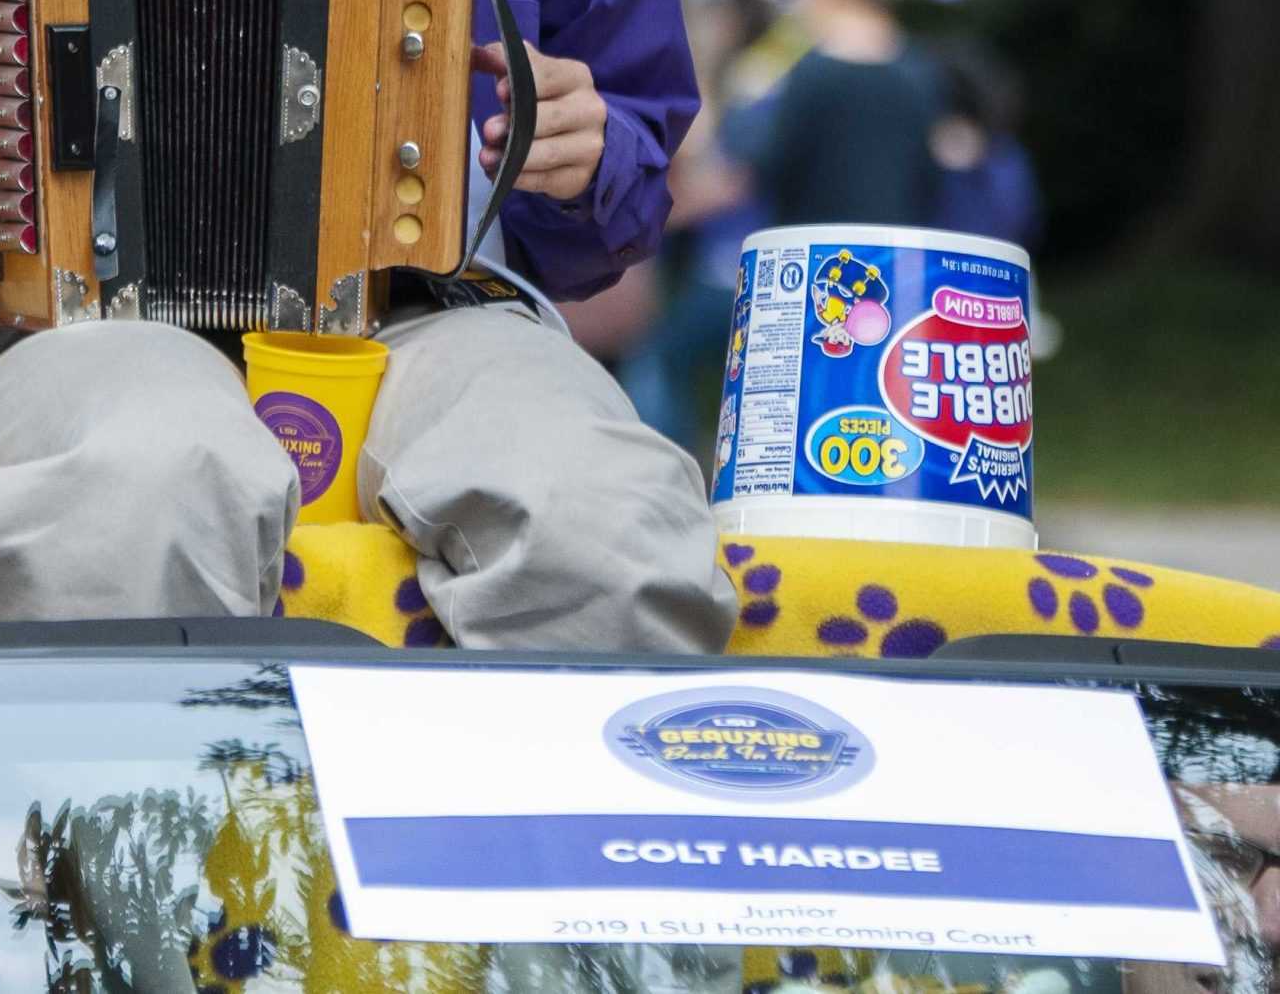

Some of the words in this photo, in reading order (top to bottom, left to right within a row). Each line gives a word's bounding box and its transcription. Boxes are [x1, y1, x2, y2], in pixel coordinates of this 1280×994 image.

[944, 295, 985, 319] GUM
[986, 304, 1021, 323] BUBBLE
[901, 339, 1031, 383] BUBBLE
[839, 417, 892, 436] PIECES
[279, 438, 322, 455] UXING
[976, 443, 1019, 462] ORIGINAL
[821, 436, 909, 478] 300
[967, 456, 1021, 478] AMERICA'S
[754, 483, 790, 493] Nutrition
[712, 717, 758, 728] LSU
[658, 728, 822, 749] GEAUXING
[661, 745, 730, 762] Back
[734, 746, 767, 761] In
[770, 747, 834, 763] Time
[601, 839, 727, 866] COLT
[737, 843, 943, 873] HARDEE
[739, 904, 839, 920] Junior
[552, 918, 629, 937] 2019
[640, 920, 705, 936] LSU
[716, 921, 936, 946] Homecoming
[946, 928, 1038, 948] Court
